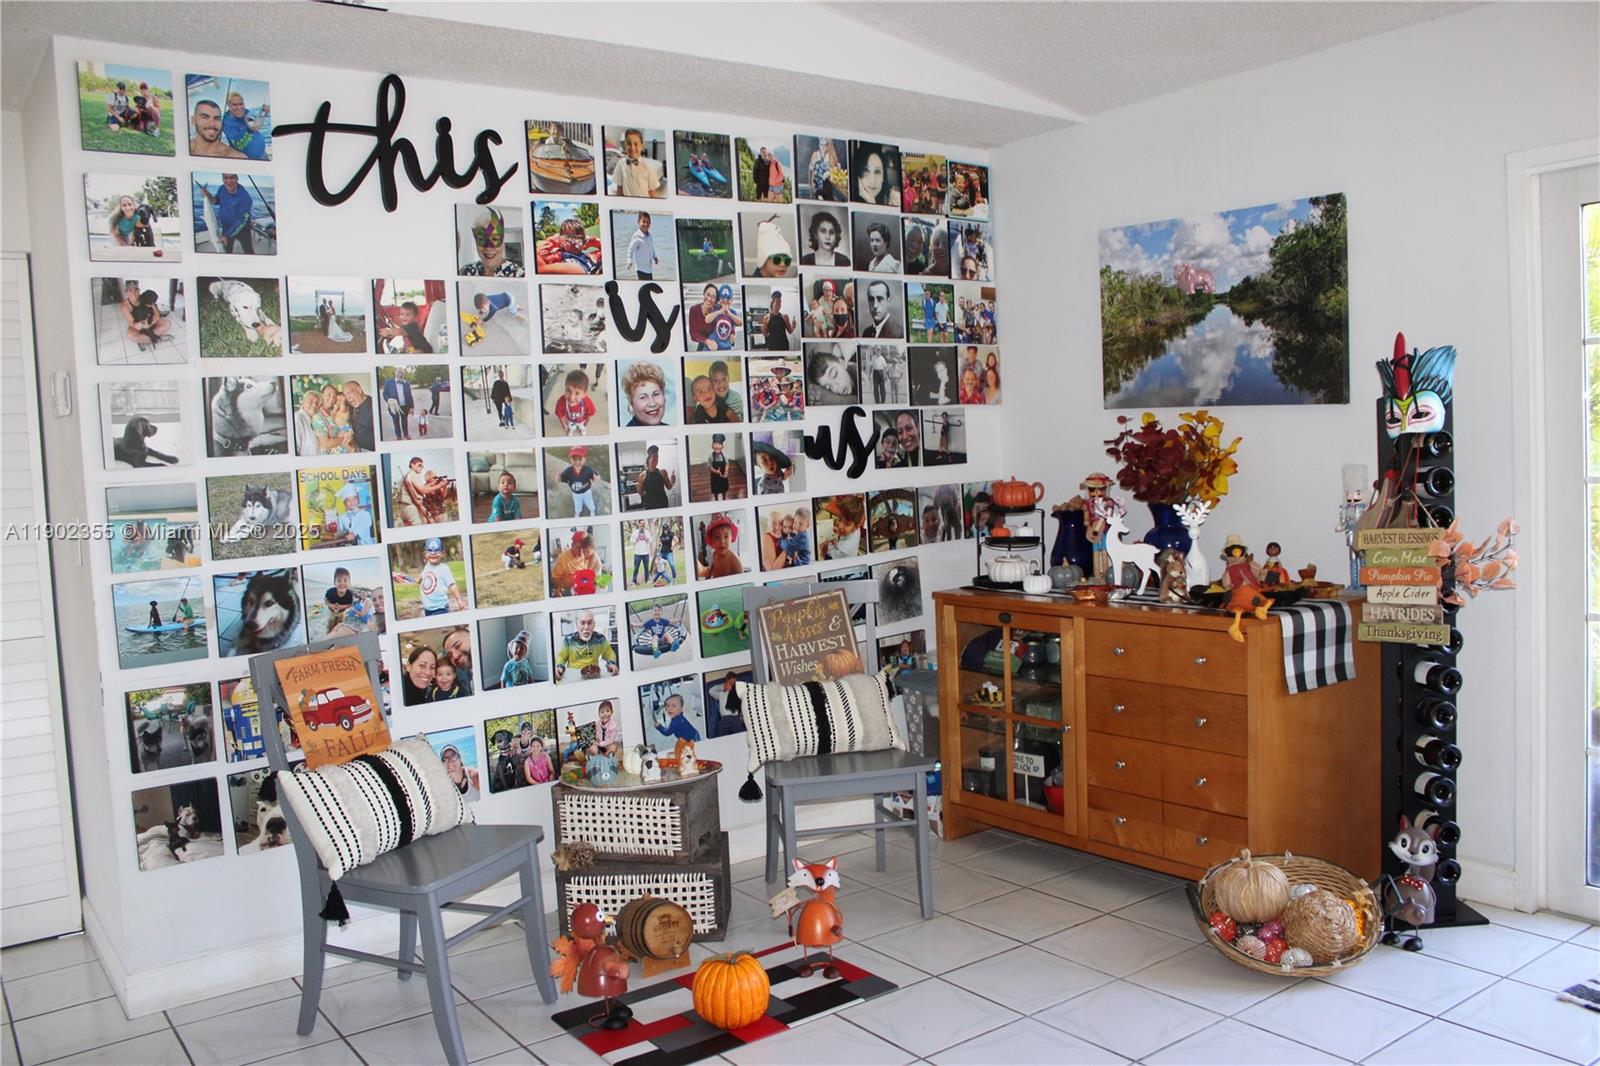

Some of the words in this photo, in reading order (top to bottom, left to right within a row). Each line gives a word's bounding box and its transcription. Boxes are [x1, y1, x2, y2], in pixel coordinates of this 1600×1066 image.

[271, 73, 520, 213] this
[604, 280, 680, 353] is
[803, 405, 881, 479] us
[299, 471, 340, 482] SCHOOL
[342, 468, 368, 480] DAYS
[1363, 532, 1397, 545] HARVEST
[1398, 532, 1439, 544] BLESSINGS
[1372, 551, 1399, 565] Corn
[1367, 568, 1411, 584] Pumpkin
[1414, 570, 1432, 581] Pie
[1376, 588, 1399, 600] Apple
[1402, 587, 1431, 599] Cider
[1368, 606, 1436, 622] HAYRIDES
[1365, 625, 1443, 641] Thanksgiving
[775, 635, 846, 661] HARVEST
[292, 662, 321, 683] FARM
[322, 659, 358, 674] FRESH
[780, 660, 818, 677] Wishes
[323, 730, 374, 757] FALL
